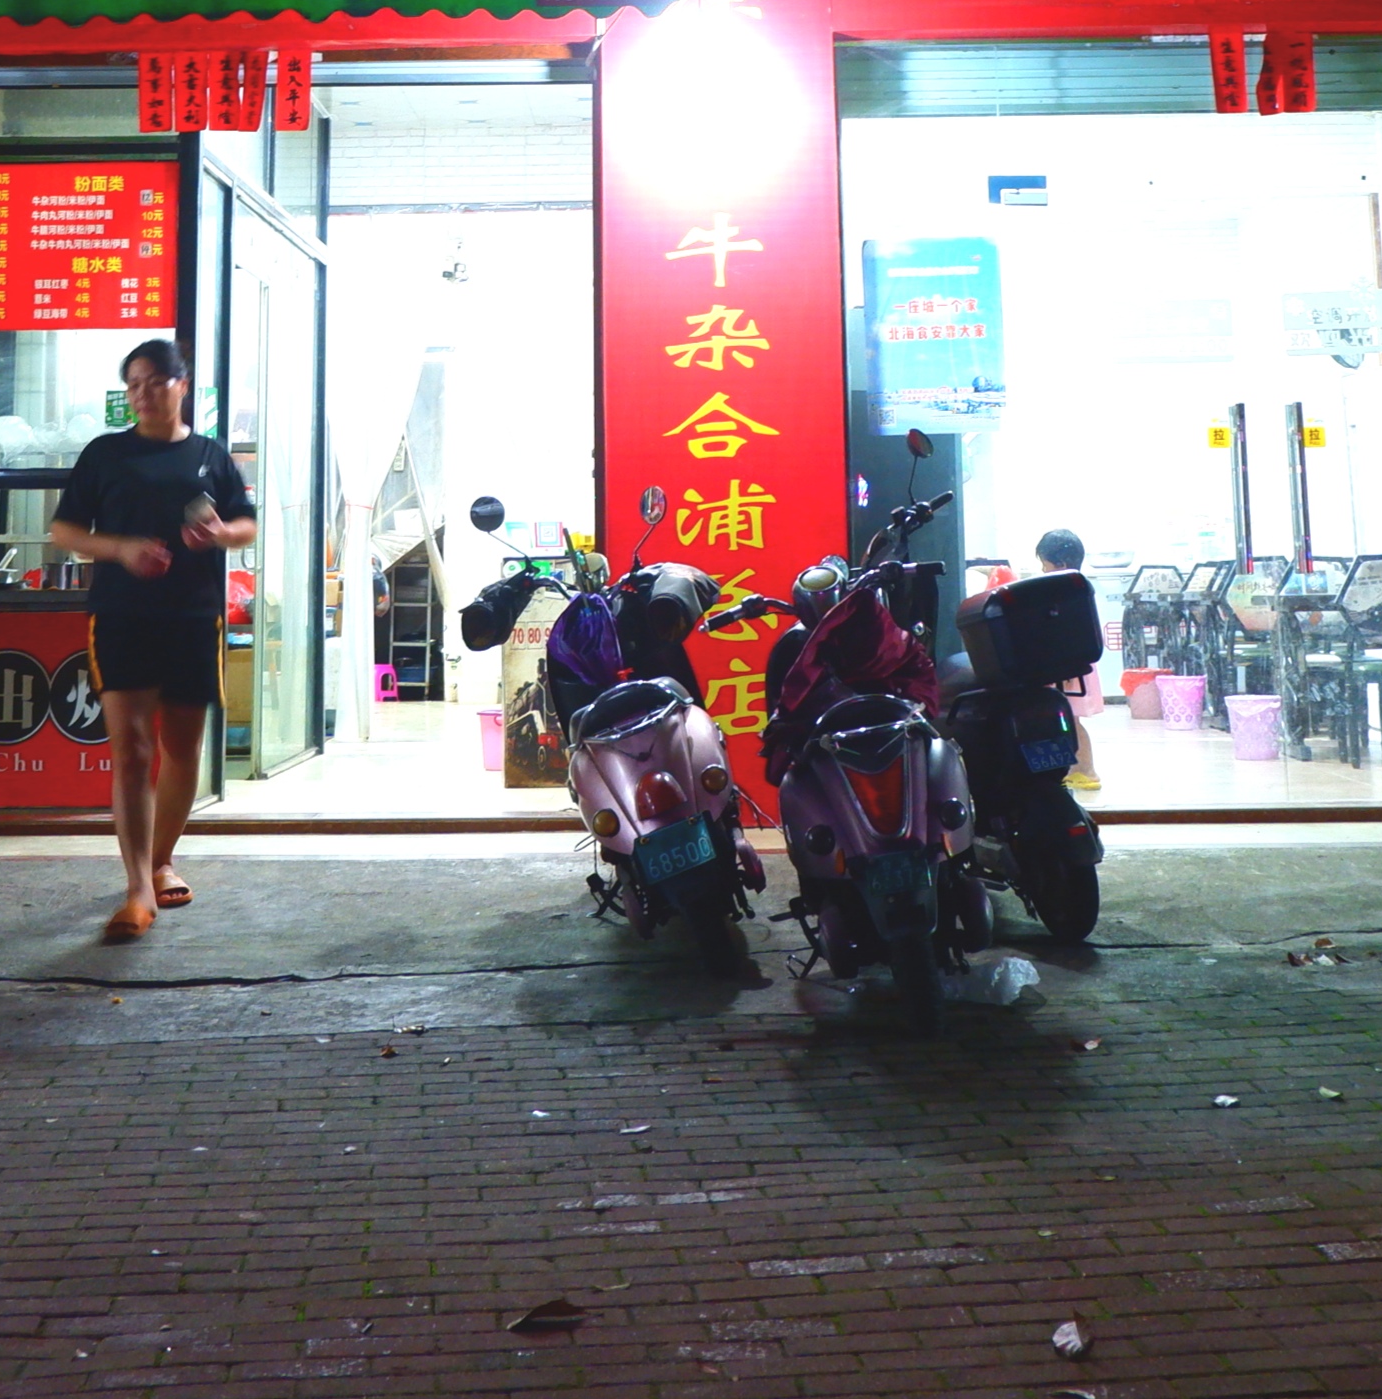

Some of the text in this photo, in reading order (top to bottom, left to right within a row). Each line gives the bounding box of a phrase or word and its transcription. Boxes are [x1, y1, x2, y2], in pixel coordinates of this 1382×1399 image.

[284, 56, 304, 127] 出入平安
[75, 176, 124, 192] 粉面类
[142, 210, 164, 221] 10元
[142, 227, 163, 238] 12元
[72, 257, 122, 273] 糖水类
[76, 278, 90, 288] 4元
[146, 278, 160, 287] 3元
[75, 293, 90, 303] 4元
[145, 292, 160, 302] 4元
[75, 308, 89, 318] 4元
[145, 307, 159, 317] 4元
[1213, 428, 1225, 441] 拉
[1309, 428, 1321, 441] 拉
